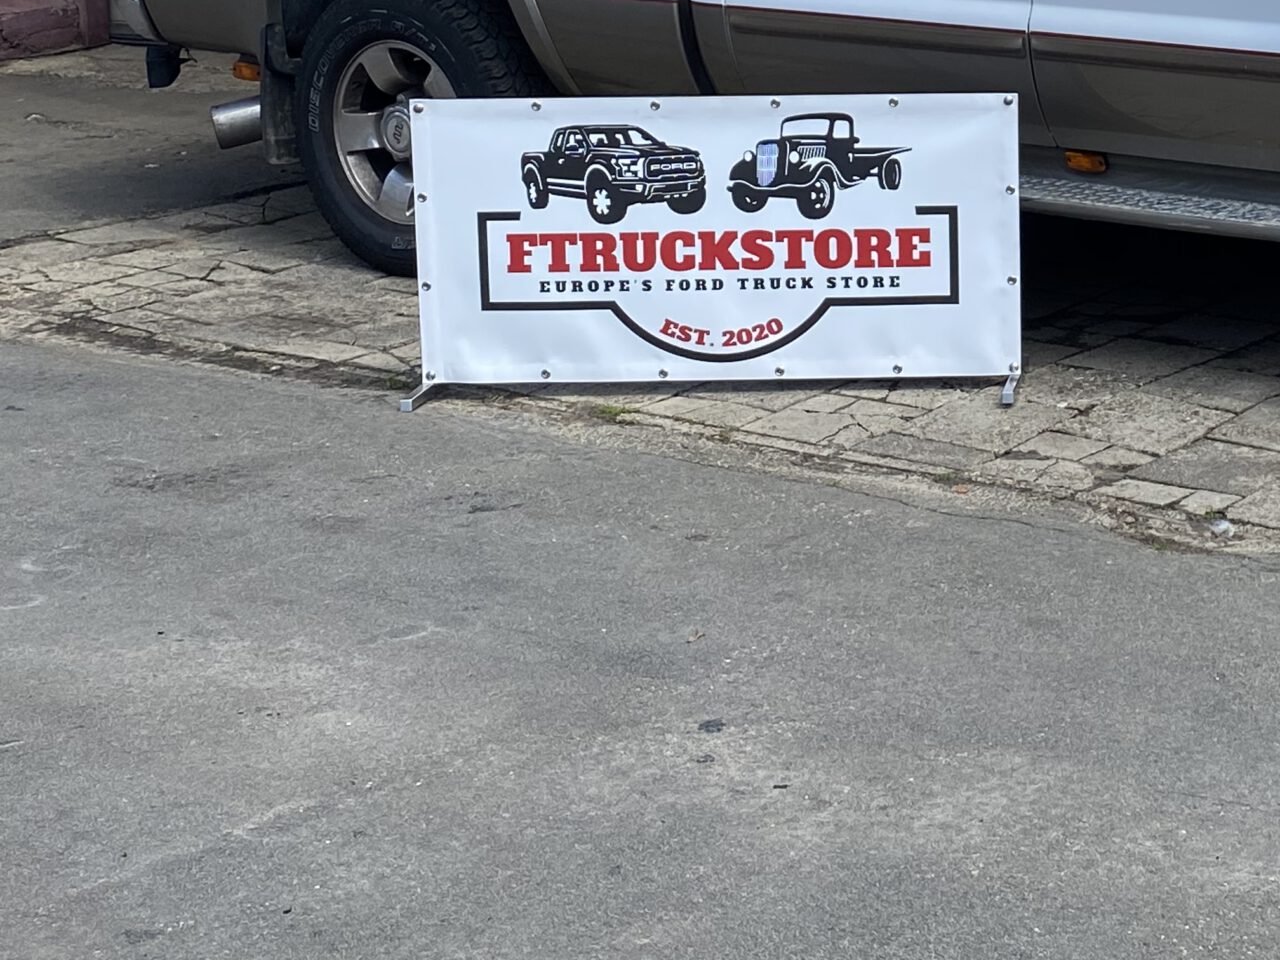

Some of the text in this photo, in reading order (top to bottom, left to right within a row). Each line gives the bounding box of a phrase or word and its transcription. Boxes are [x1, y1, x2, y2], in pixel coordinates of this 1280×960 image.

[308, 18, 382, 133] DISCOVERER
[650, 162, 697, 171] FORD
[506, 228, 931, 273] FTRUCKSTORE
[539, 276, 901, 293] EUROPE'S FORD TRUCK STORE
[659, 318, 783, 347] EST. 2020
